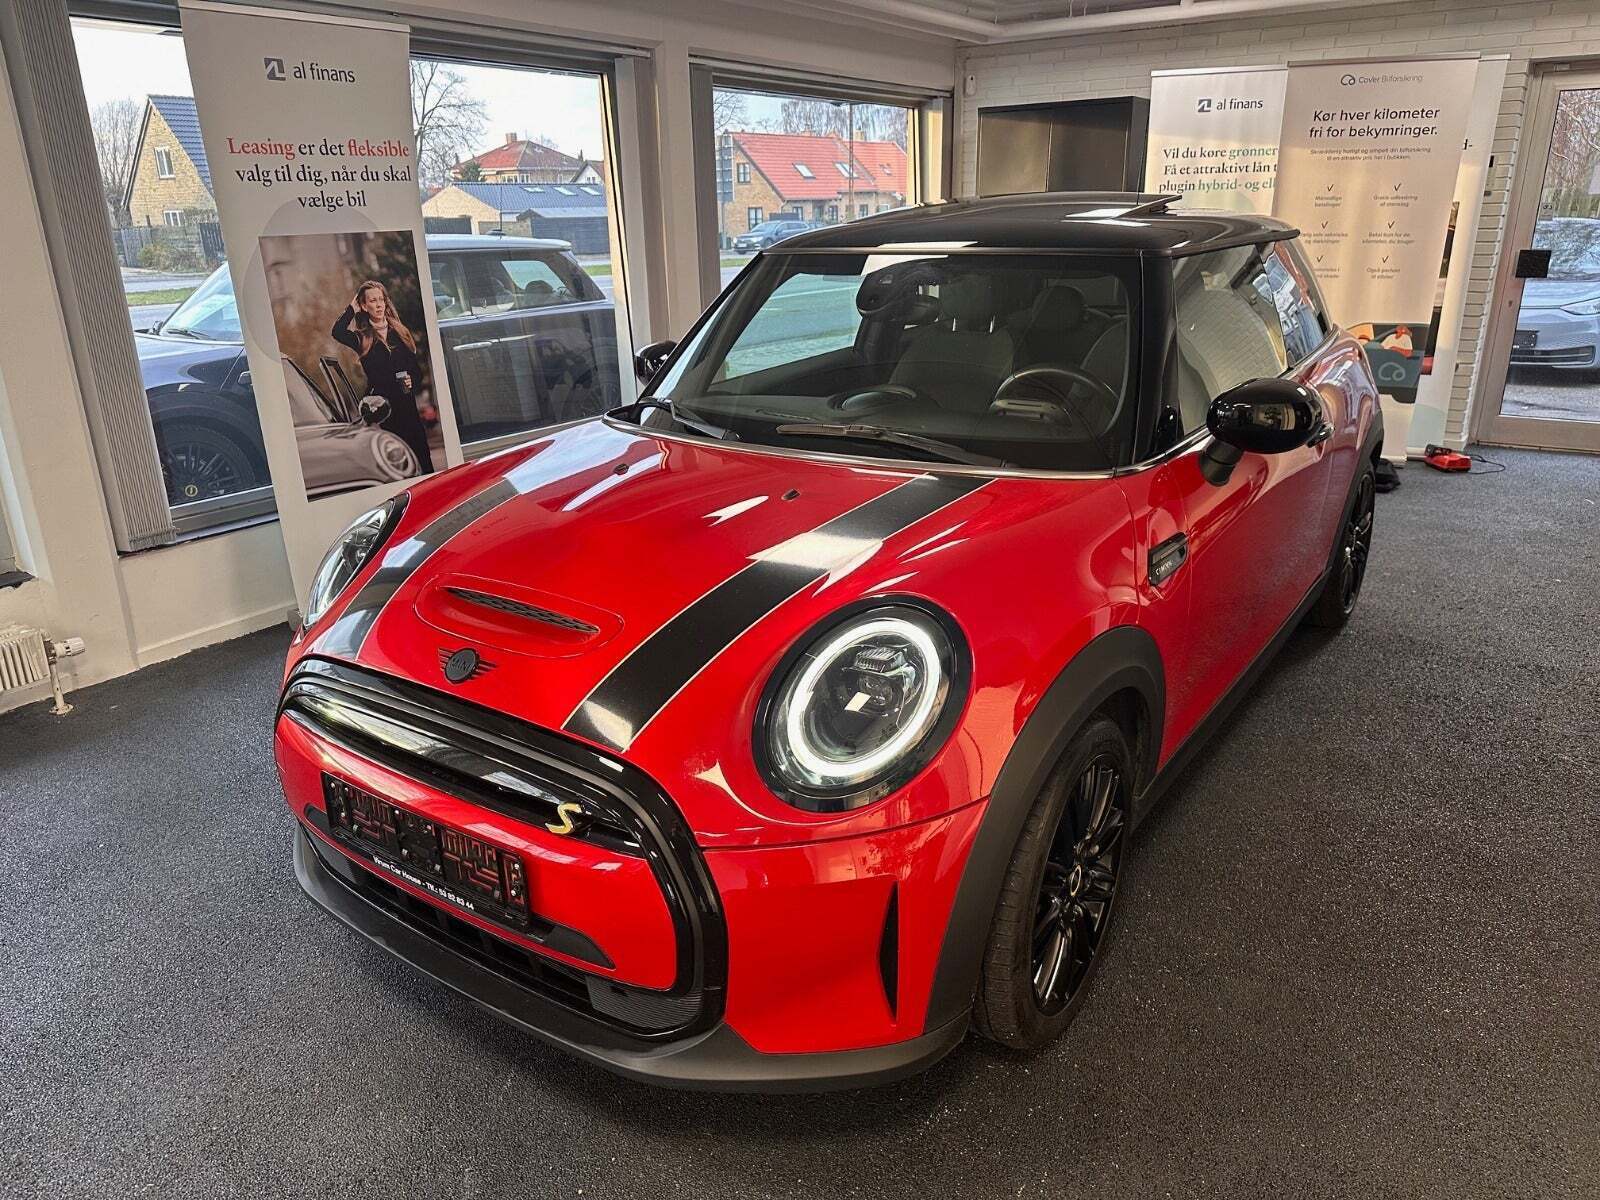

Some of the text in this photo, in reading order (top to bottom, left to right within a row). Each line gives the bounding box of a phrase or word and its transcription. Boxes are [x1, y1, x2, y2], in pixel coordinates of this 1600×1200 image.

[293, 62, 355, 83] al finans
[1216, 98, 1263, 111] al finans
[1313, 108, 1440, 122] Kør hver kilometer
[1309, 124, 1438, 139] fri for bekymringer.
[226, 137, 409, 160] Leasing er det fleksible
[1163, 148, 1179, 159] Vil
[1182, 147, 1197, 159] du
[235, 164, 411, 187] valg til dig, når du skal
[1164, 163, 1177, 175] Få
[1180, 165, 1192, 175] et
[1193, 162, 1251, 175] attraktivt
[1253, 162, 1270, 173] lån
[1159, 180, 1195, 193] plugin
[1198, 179, 1242, 193] hybrid-
[1244, 181, 1260, 192] og
[298, 190, 367, 212] vælge bil
[545, 802, 582, 835] S
